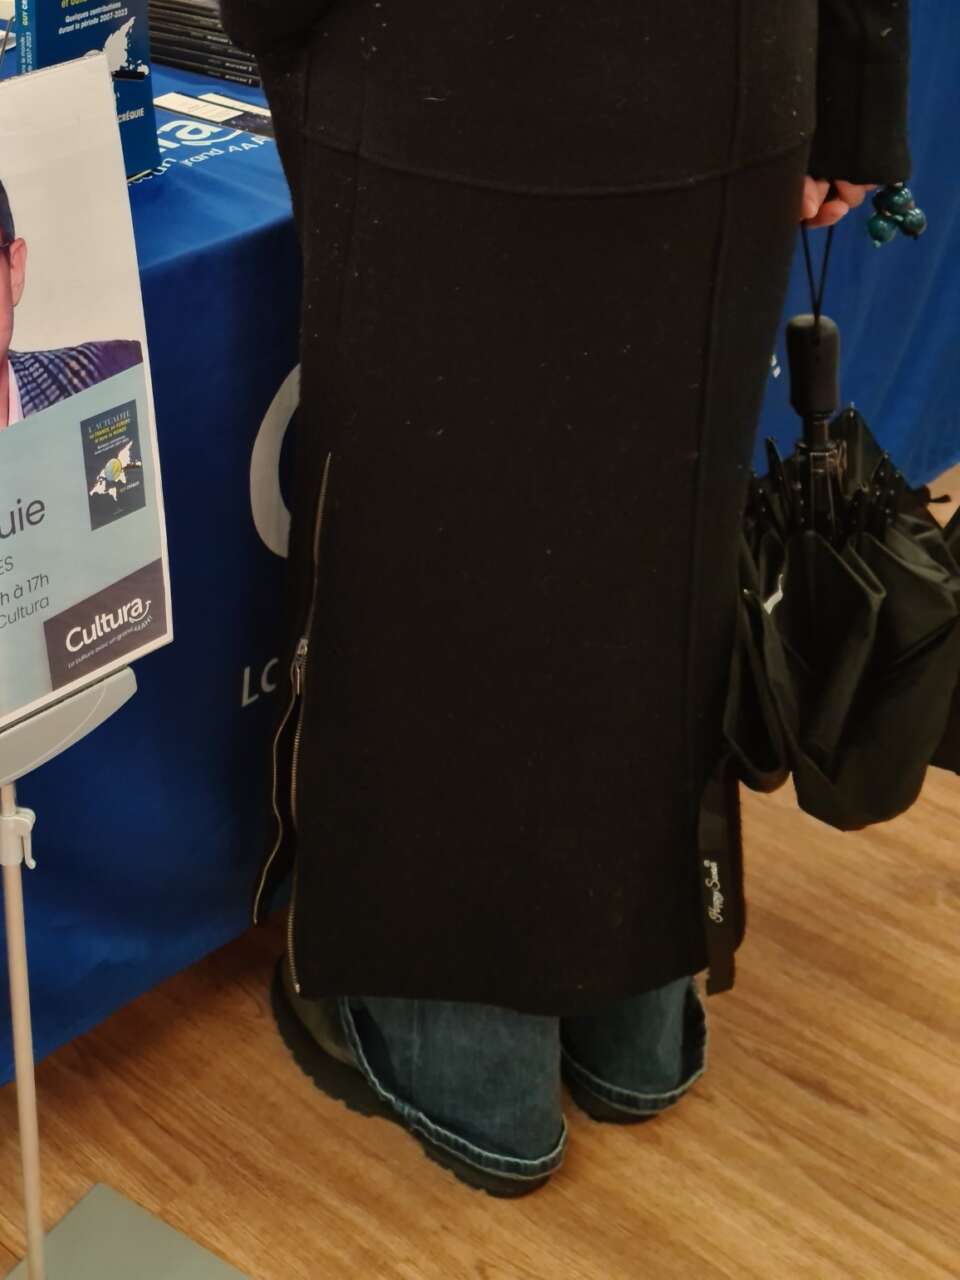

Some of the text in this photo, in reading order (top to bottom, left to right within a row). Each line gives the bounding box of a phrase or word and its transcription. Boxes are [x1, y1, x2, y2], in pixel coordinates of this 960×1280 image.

[13, 584, 24, 599] à
[27, 573, 50, 593] 17h
[66, 598, 152, 652] Cultura
